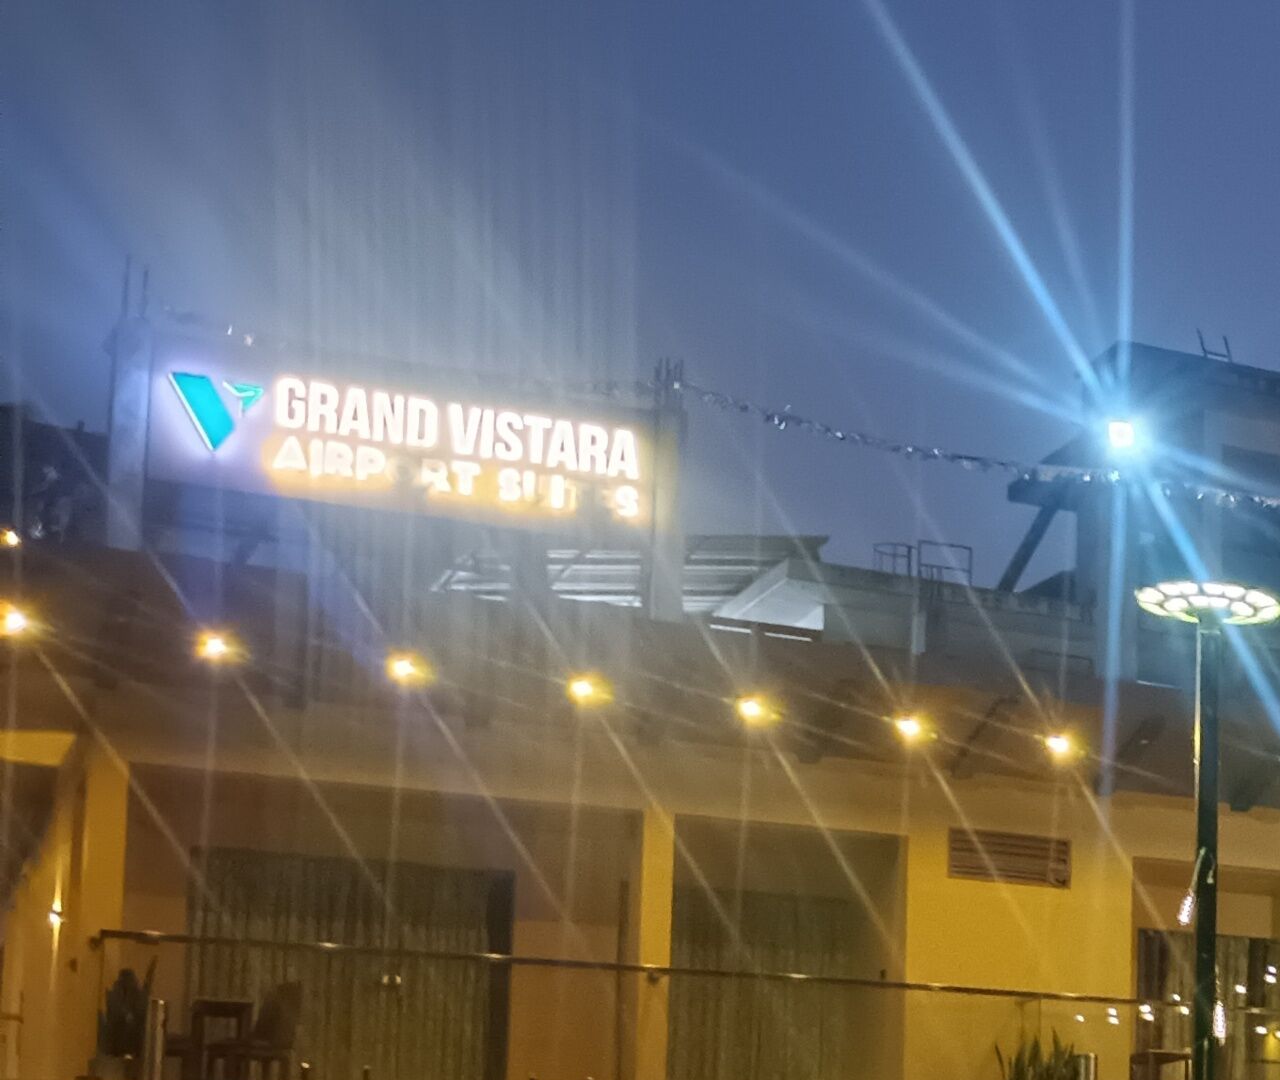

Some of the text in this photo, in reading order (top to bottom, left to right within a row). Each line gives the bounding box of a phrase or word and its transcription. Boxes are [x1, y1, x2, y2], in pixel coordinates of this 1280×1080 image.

[271, 434, 482, 497] AIRPRT
[275, 376, 641, 482] GRAND VISTARA
